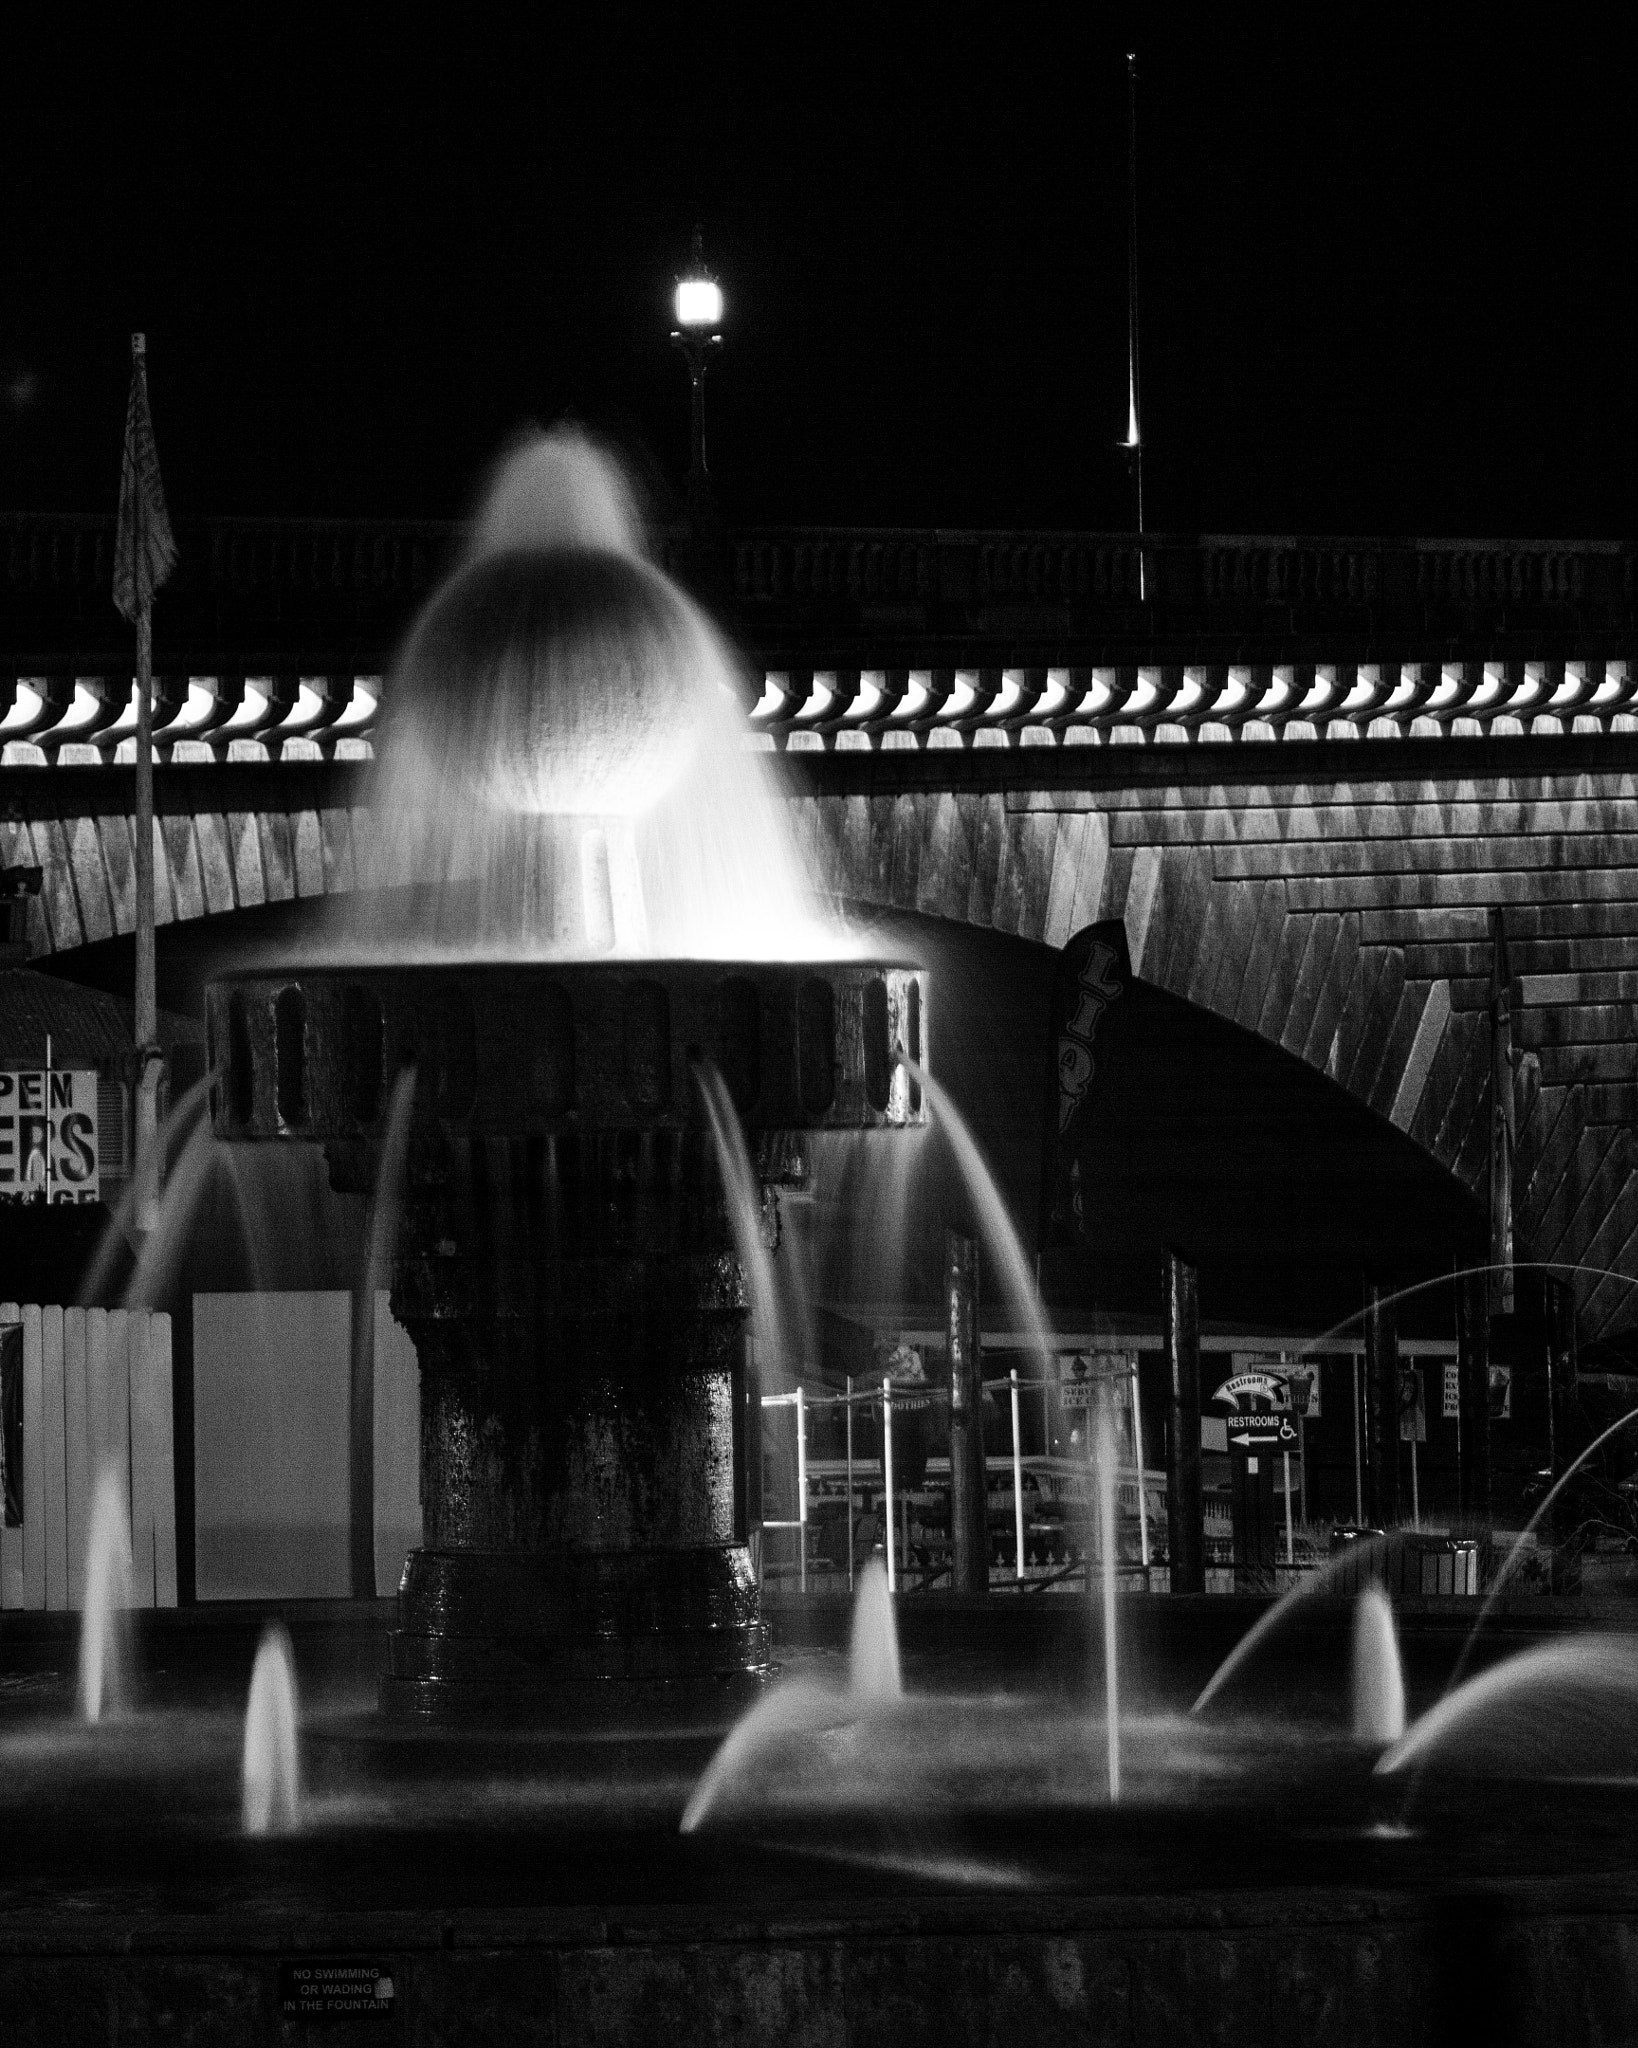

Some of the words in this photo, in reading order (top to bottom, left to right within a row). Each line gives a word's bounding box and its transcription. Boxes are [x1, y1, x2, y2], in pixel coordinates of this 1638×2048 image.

[1226, 1377, 1267, 1391] Restrooms
[1228, 1416, 1280, 1427] RESTROOMS
[293, 1969, 311, 1979] NO
[314, 1968, 380, 1979] SWIMMING
[300, 1985, 319, 1995] OR
[321, 1984, 372, 1995] WADING
[283, 2001, 296, 2011] IN
[300, 2000, 323, 2011] THE
[327, 2000, 389, 2010] FOUNTAIN
